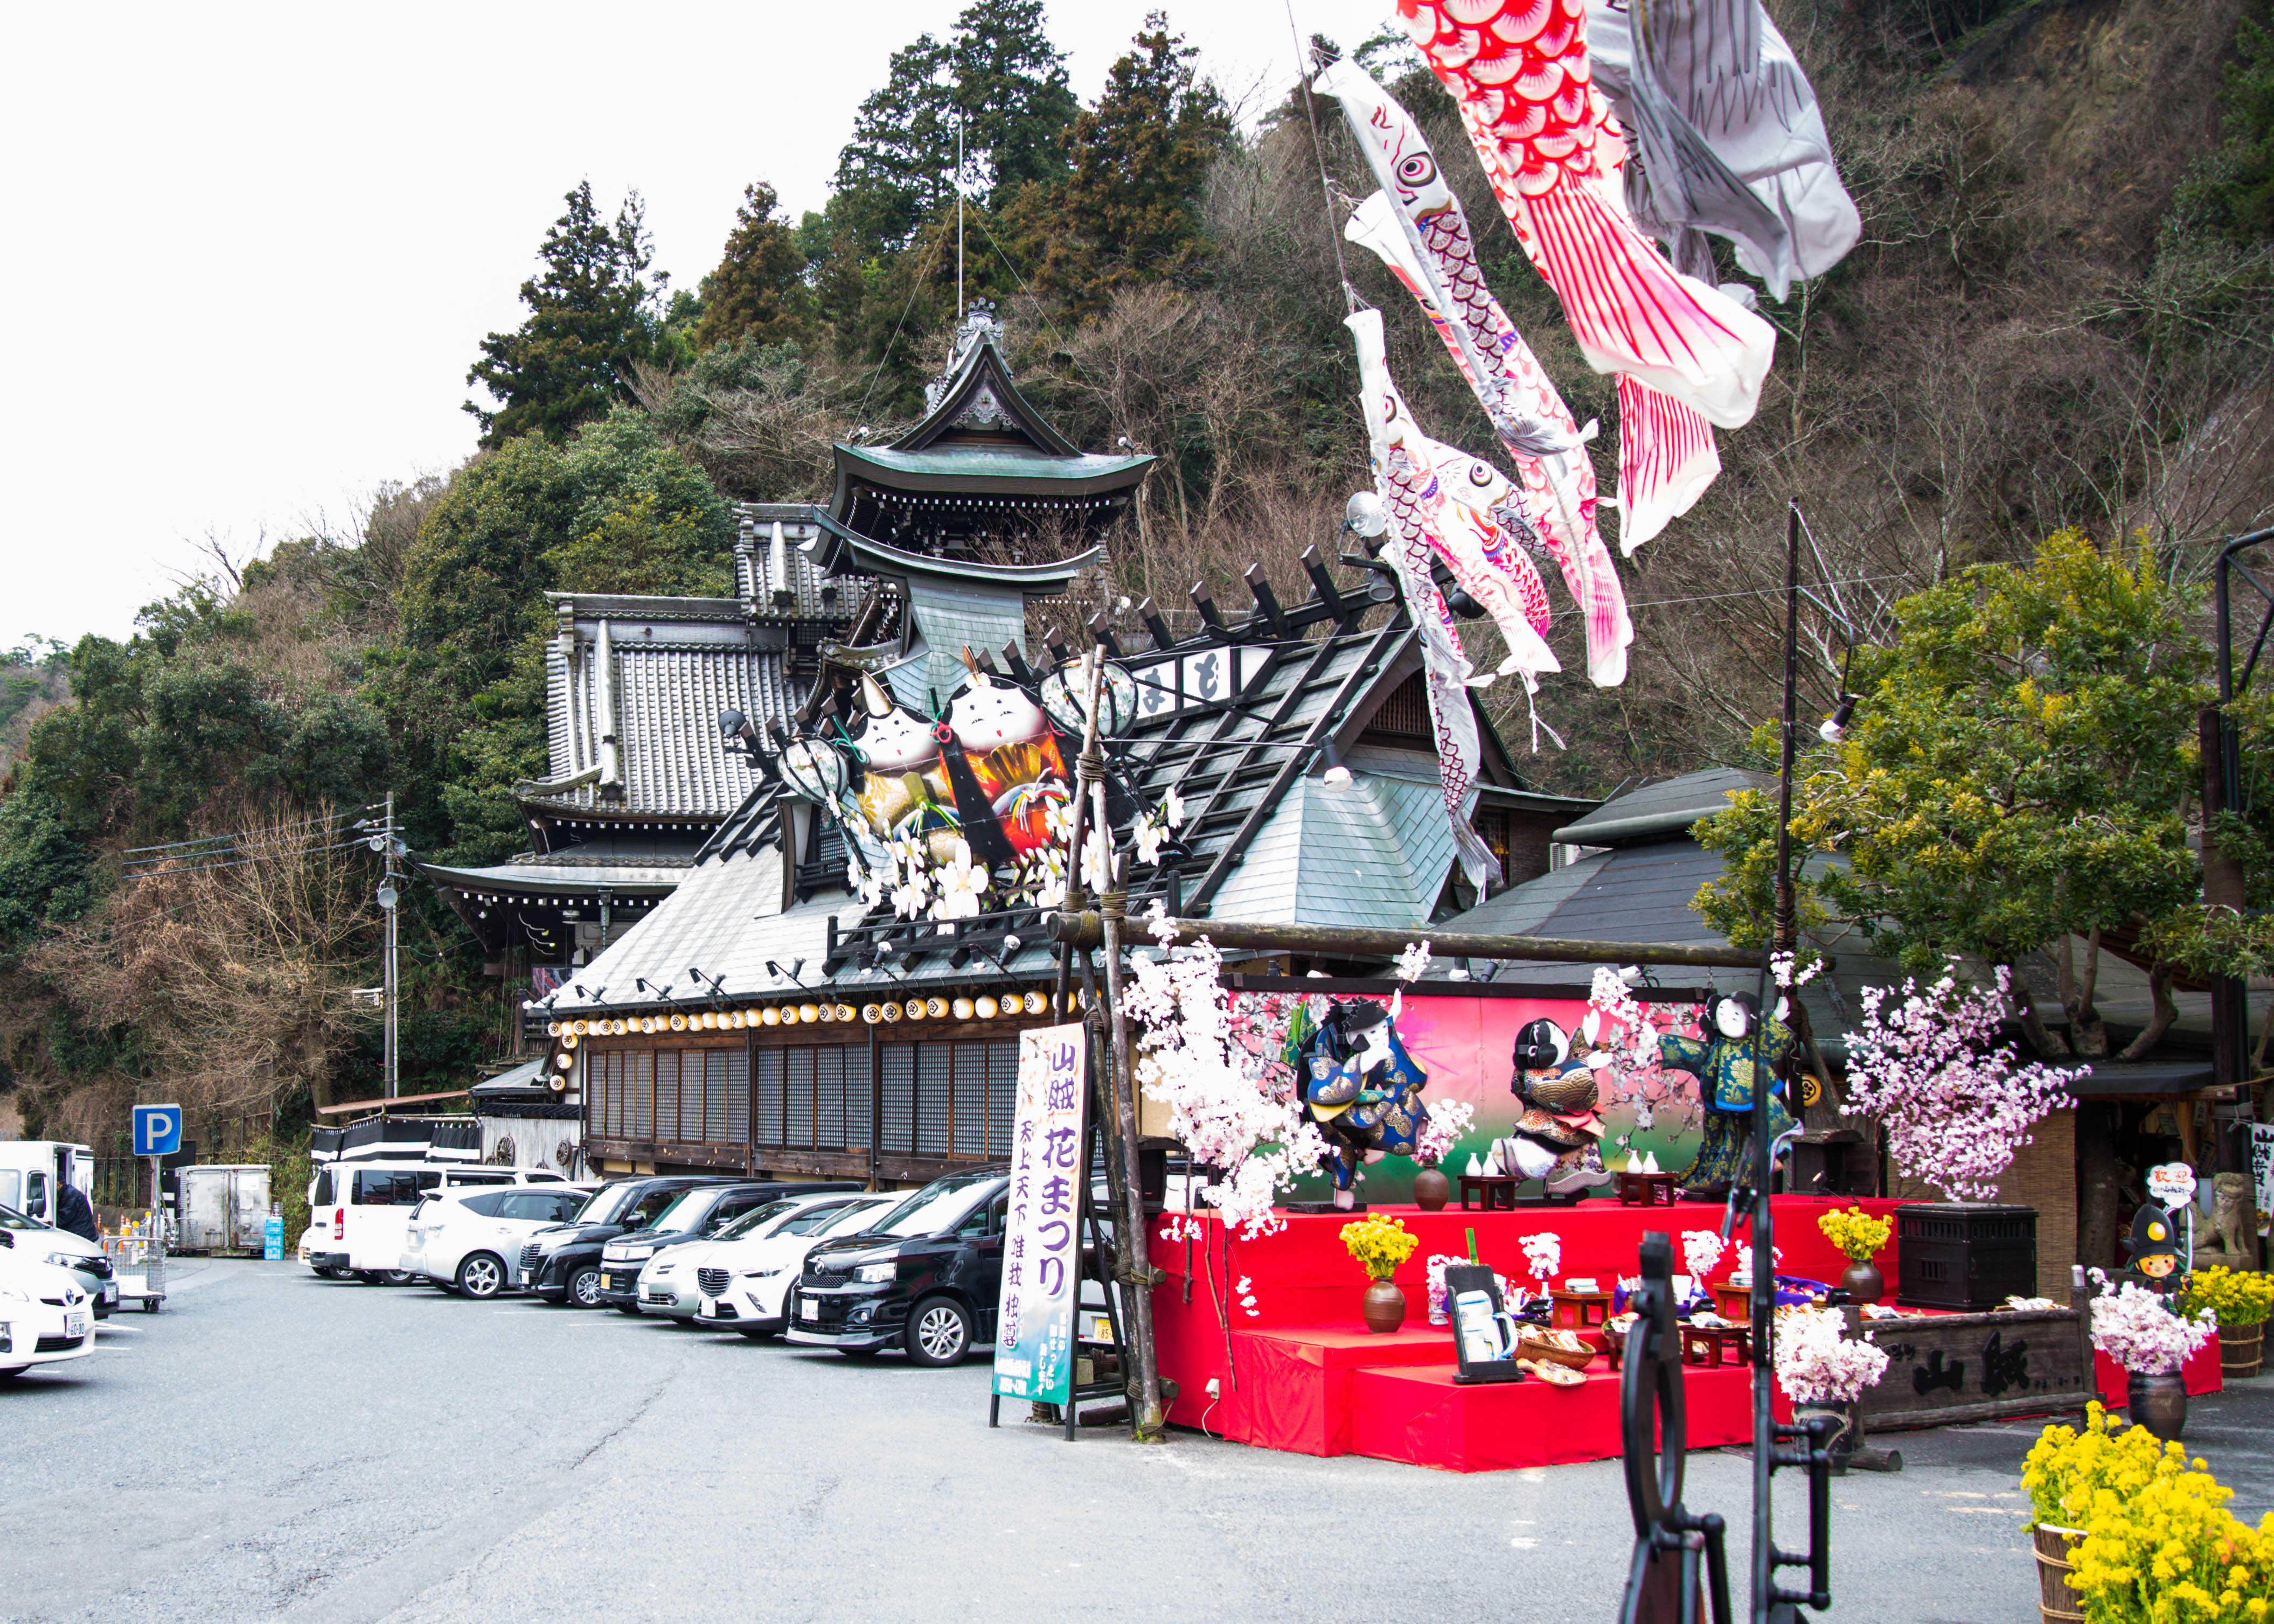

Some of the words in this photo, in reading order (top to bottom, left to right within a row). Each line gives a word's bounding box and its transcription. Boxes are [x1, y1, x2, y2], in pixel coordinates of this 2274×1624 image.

[147, 1113, 172, 1149] P
[2154, 1170, 2189, 1183] 歓迎
[1038, 1127, 1076, 1295] 花まつり
